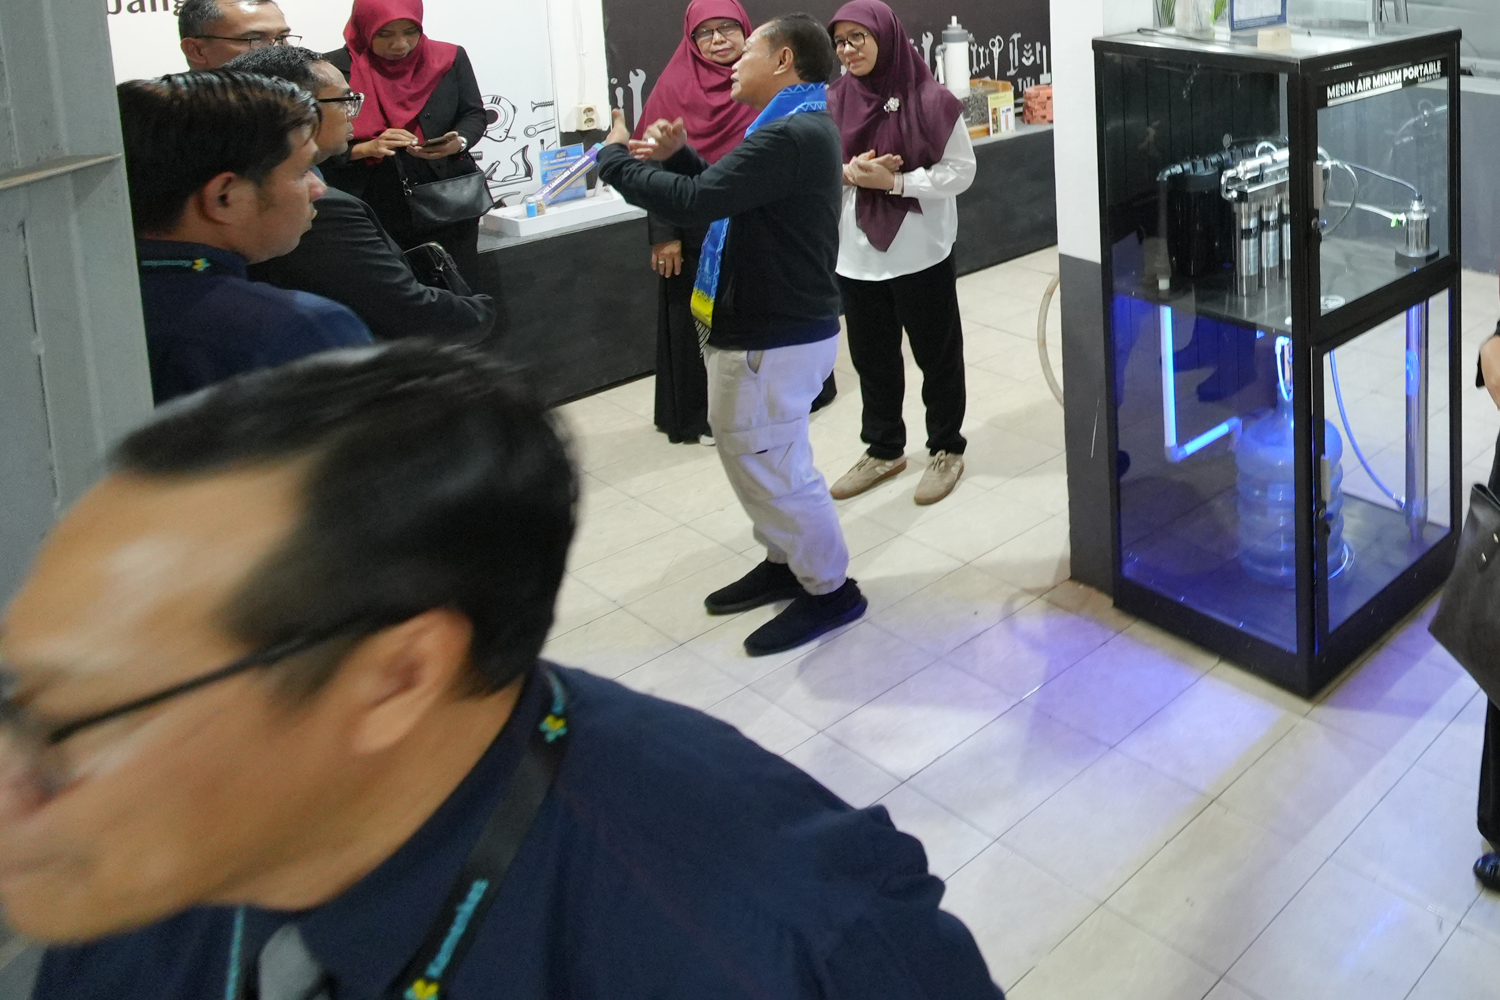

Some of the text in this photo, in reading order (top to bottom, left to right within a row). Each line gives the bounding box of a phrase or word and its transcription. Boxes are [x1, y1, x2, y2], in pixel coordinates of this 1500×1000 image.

[1326, 80, 1355, 100] MESIN
[1356, 77, 1372, 92] AIR
[1372, 68, 1402, 89] MINUM
[1403, 60, 1442, 81] PORTABLE
